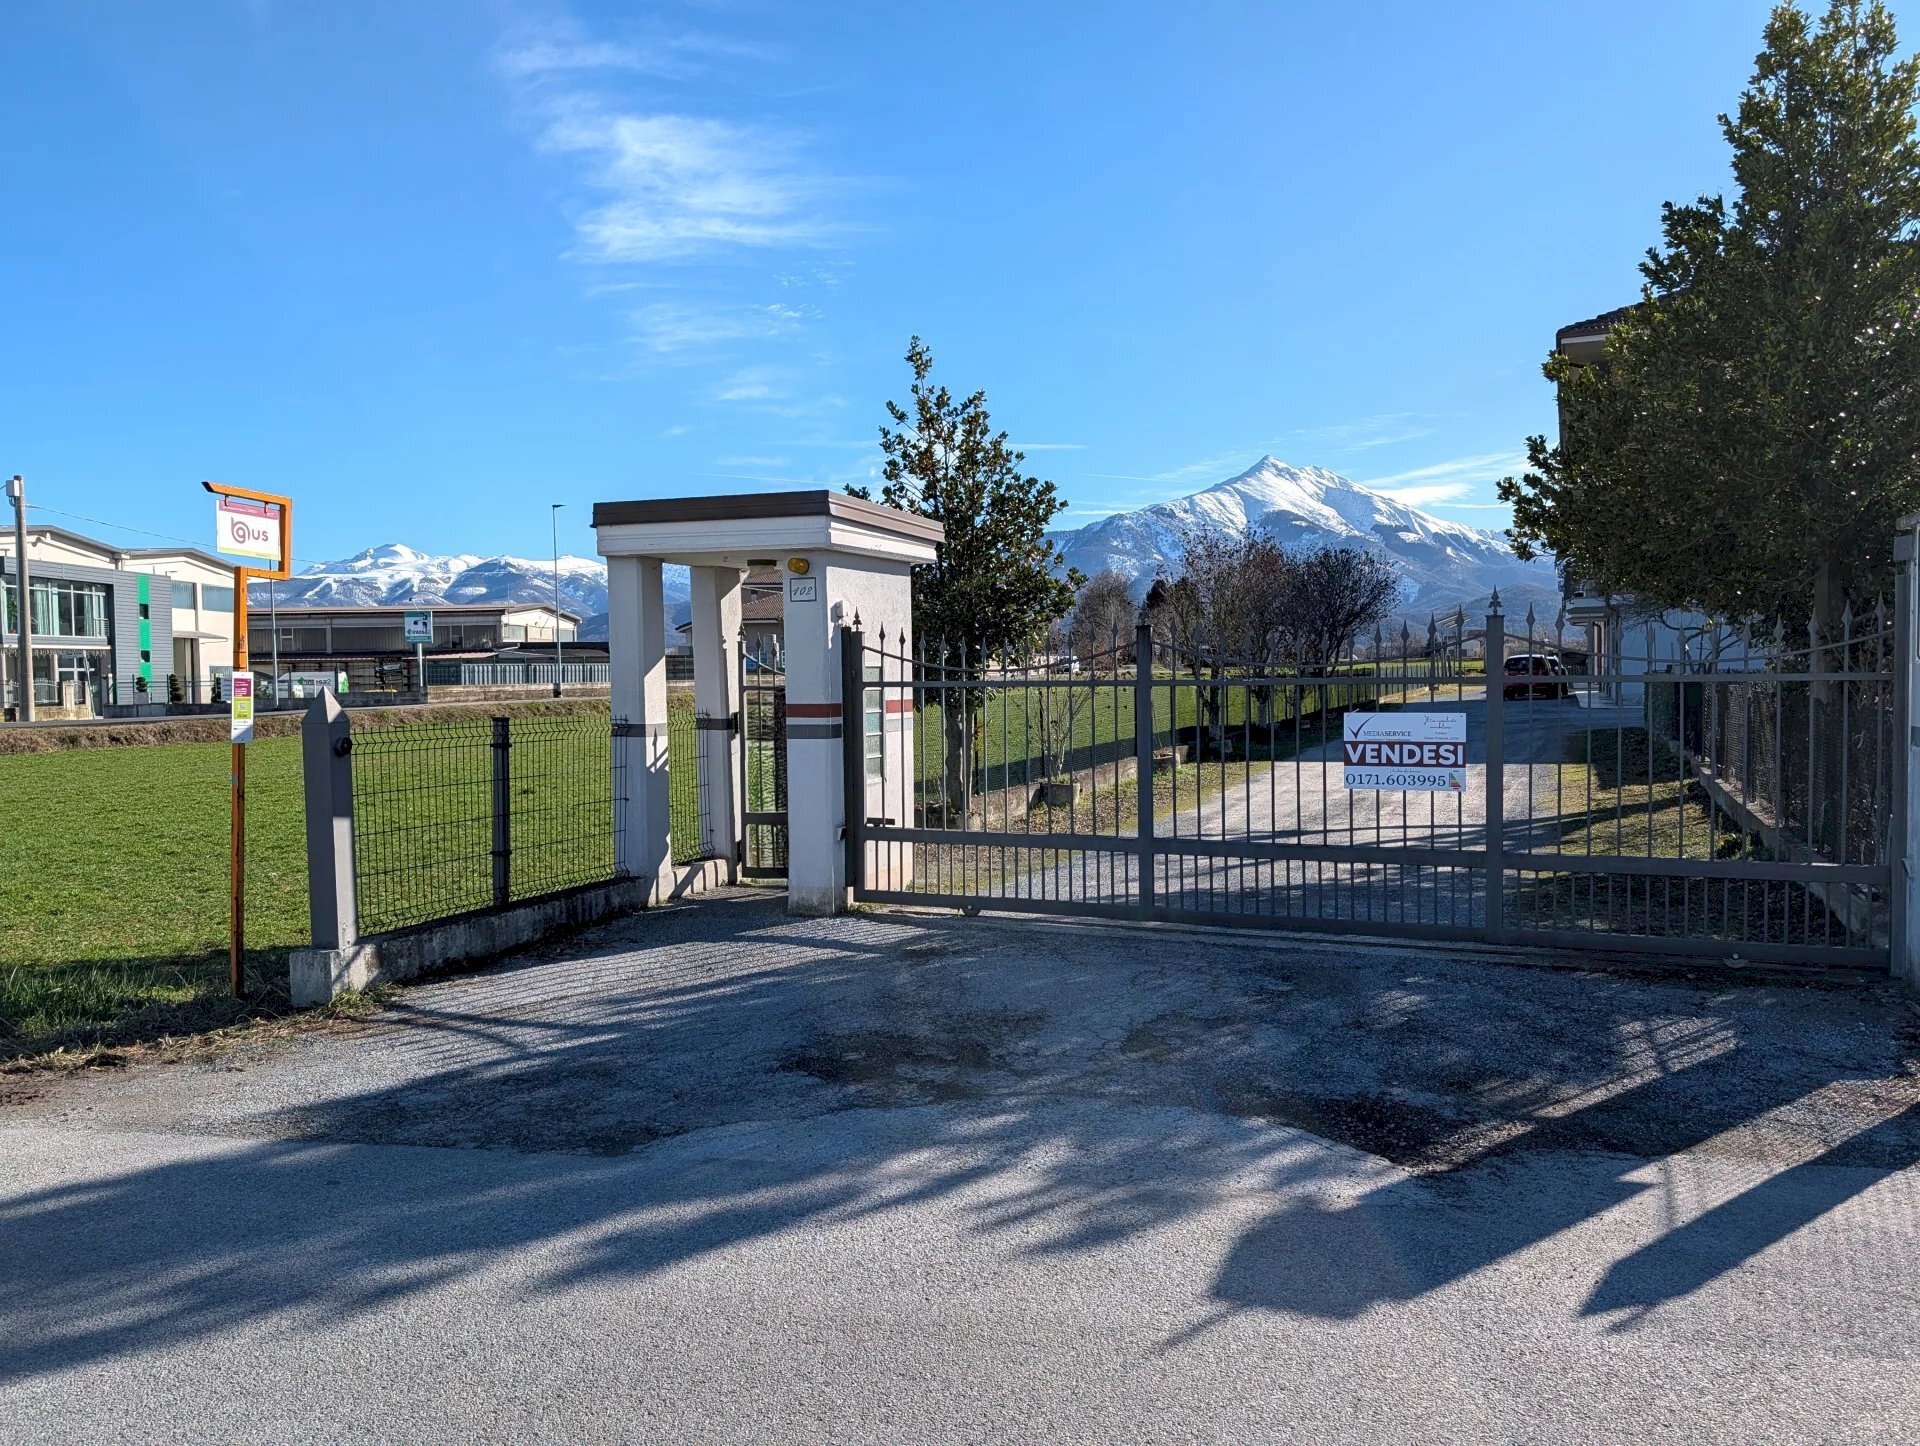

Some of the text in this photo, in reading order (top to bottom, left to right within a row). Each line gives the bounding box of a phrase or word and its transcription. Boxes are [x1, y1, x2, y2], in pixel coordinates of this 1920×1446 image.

[793, 586, 812, 596] 102
[1345, 743, 1463, 765] VENDESI
[1345, 773, 1446, 787] 0171.603995
